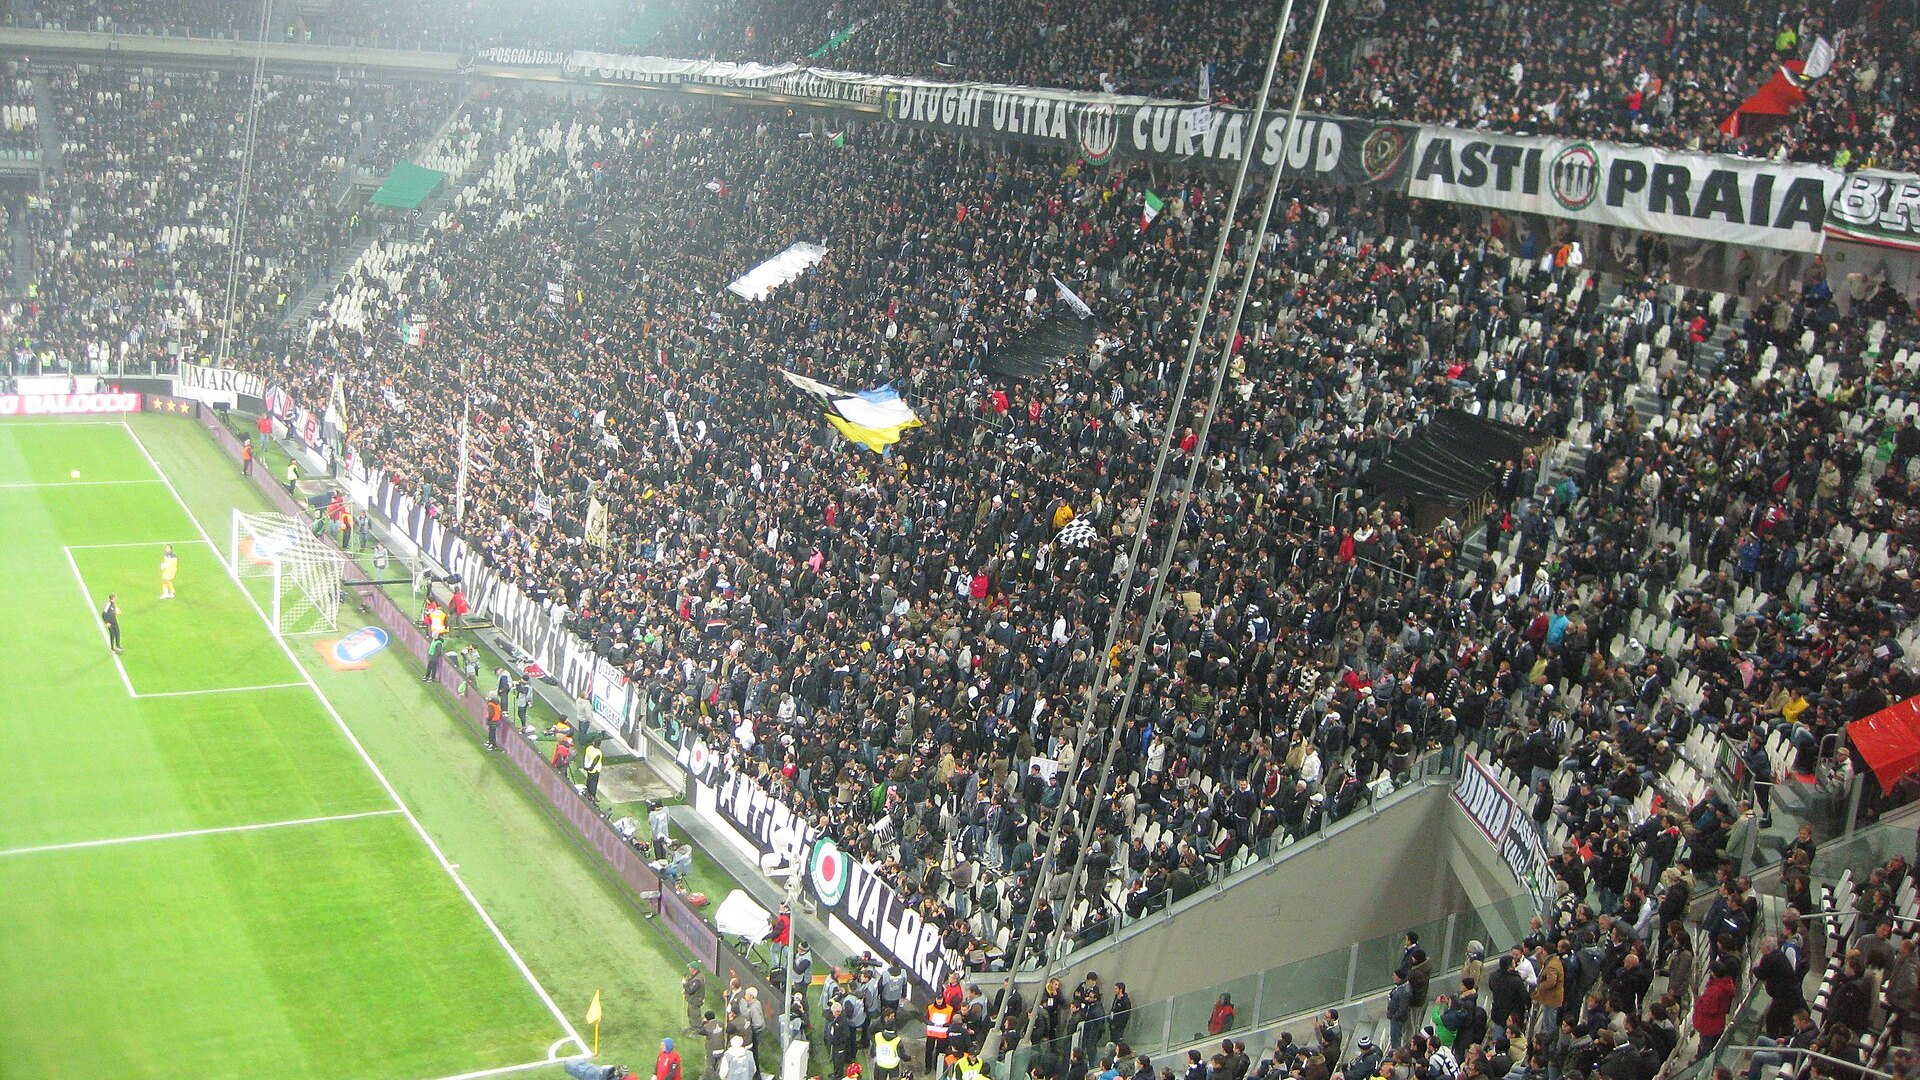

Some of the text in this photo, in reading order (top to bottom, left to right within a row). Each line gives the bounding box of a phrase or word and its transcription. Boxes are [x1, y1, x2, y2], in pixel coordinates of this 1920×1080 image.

[899, 89, 982, 128] DRUGHI
[1132, 106, 1244, 161] CURVA
[1261, 116, 1342, 172] SUD
[1416, 139, 1544, 194] ASTI
[1606, 159, 1826, 232] PRAIA
[24, 393, 138, 414] BALOCCO
